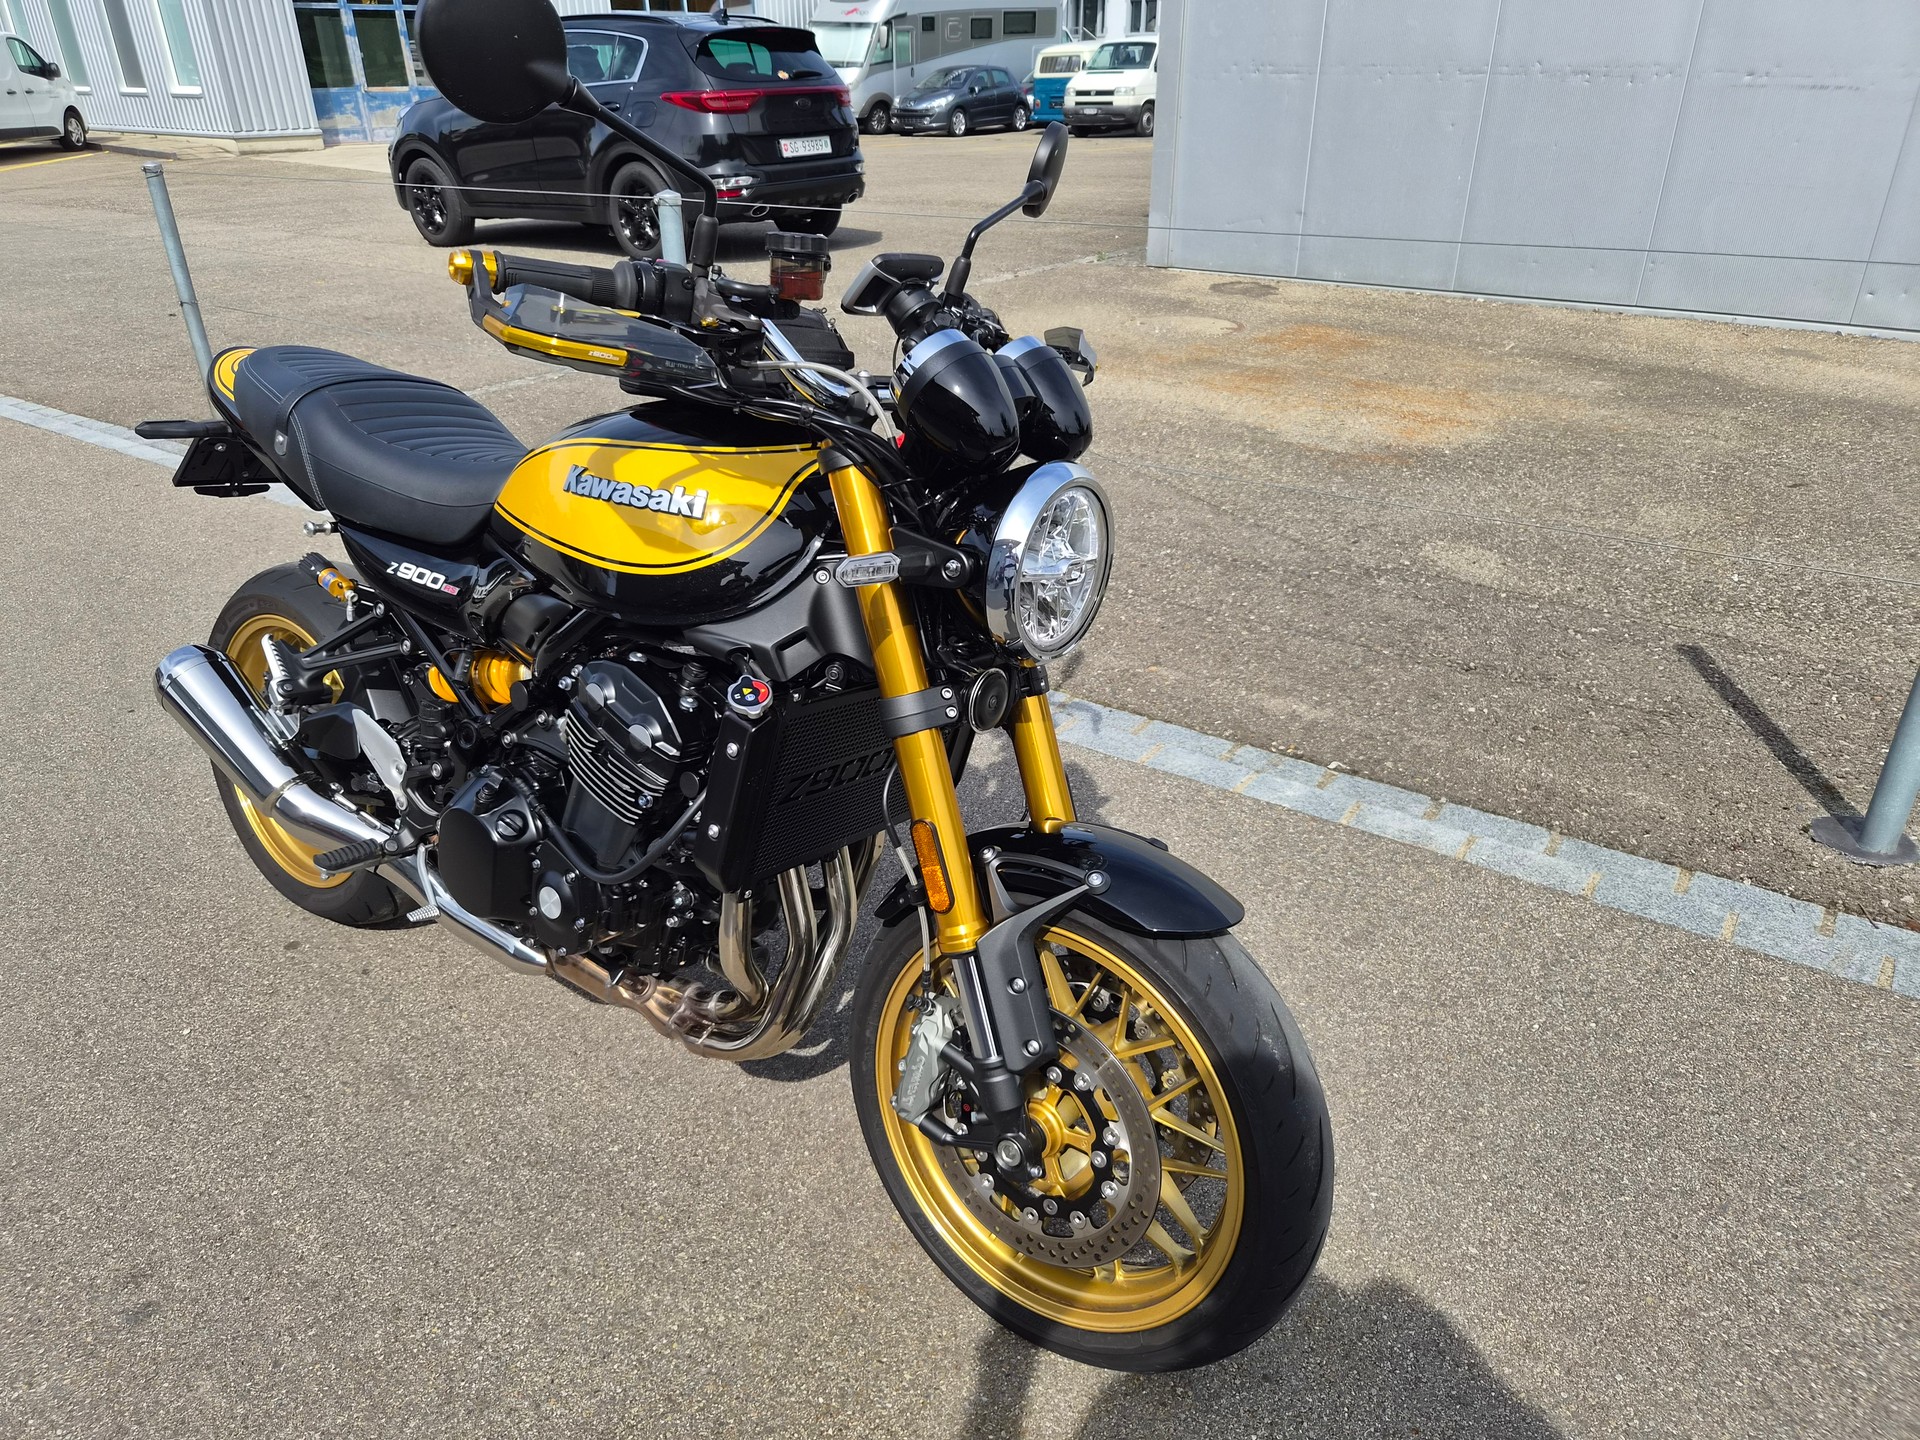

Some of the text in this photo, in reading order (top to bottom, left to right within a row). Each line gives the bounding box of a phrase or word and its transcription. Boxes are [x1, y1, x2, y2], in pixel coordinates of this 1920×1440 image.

[790, 141, 799, 153] SG
[563, 464, 708, 520] Kawasaki
[778, 746, 896, 805] Z900
